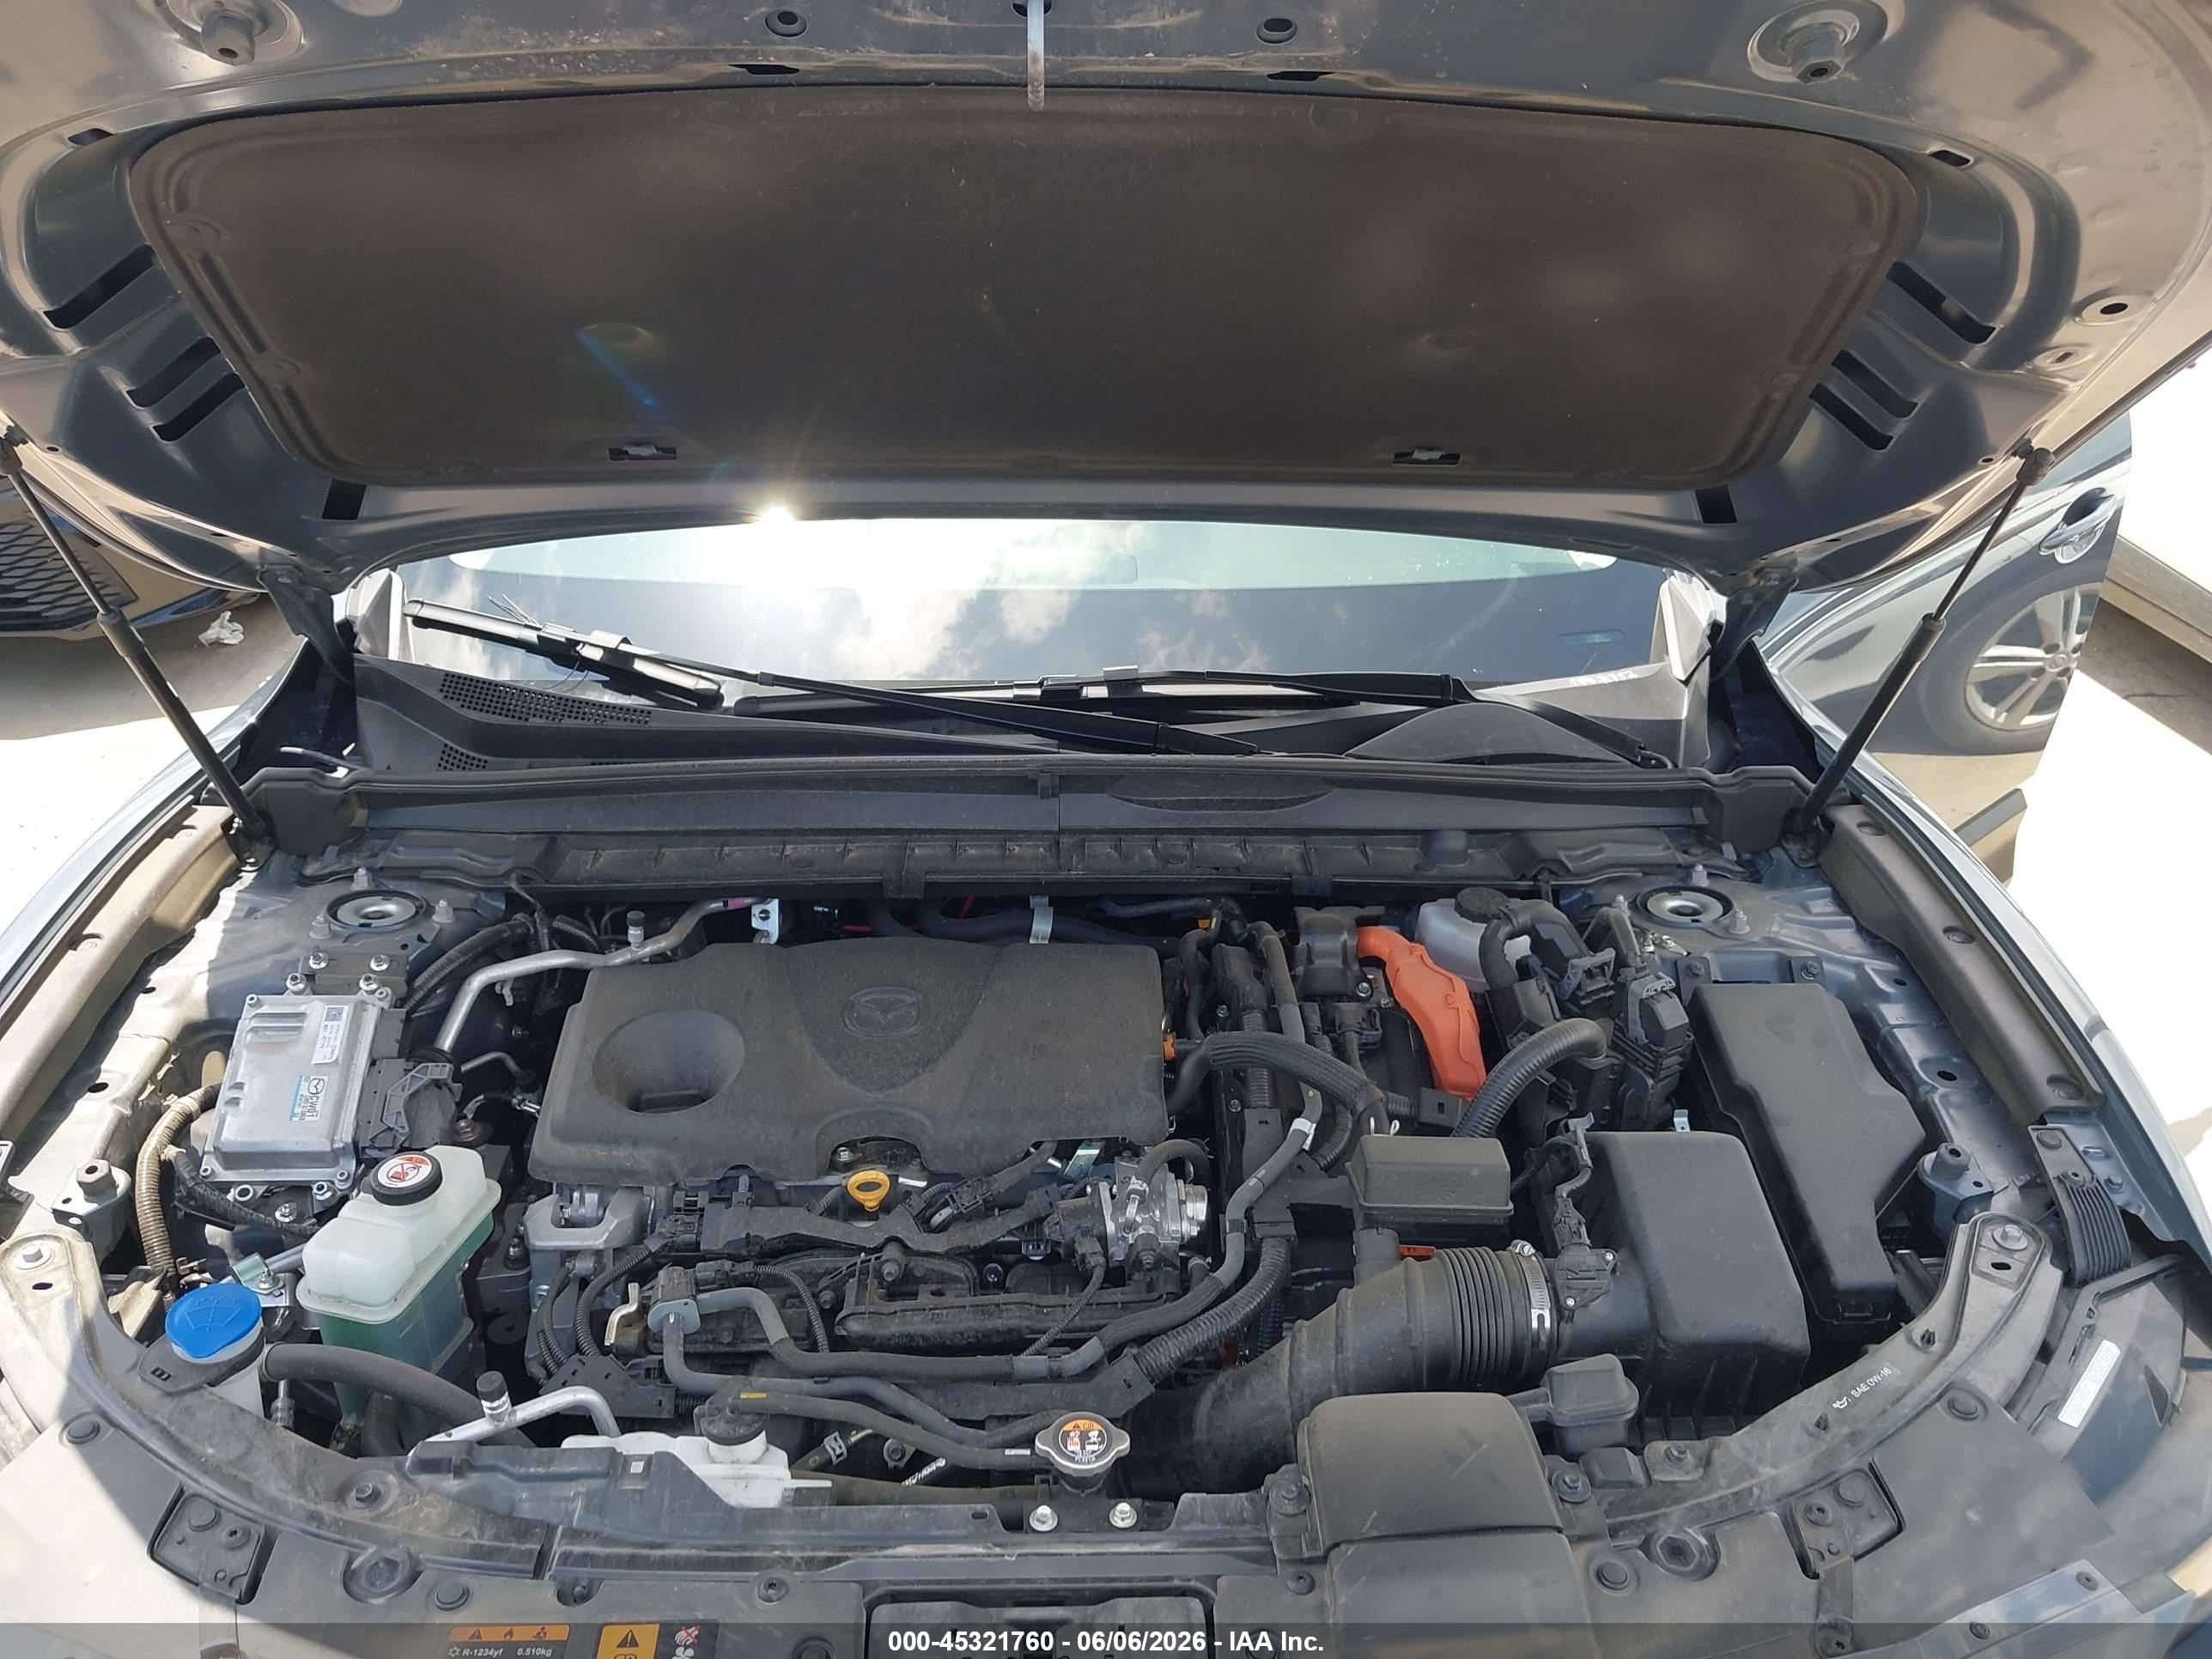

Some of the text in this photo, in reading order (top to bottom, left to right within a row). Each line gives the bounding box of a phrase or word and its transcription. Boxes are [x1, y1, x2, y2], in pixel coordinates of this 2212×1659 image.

[1850, 1382, 1869, 1398] SAE
[462, 1647, 553, 1658] R-1234yf 0.510kg
